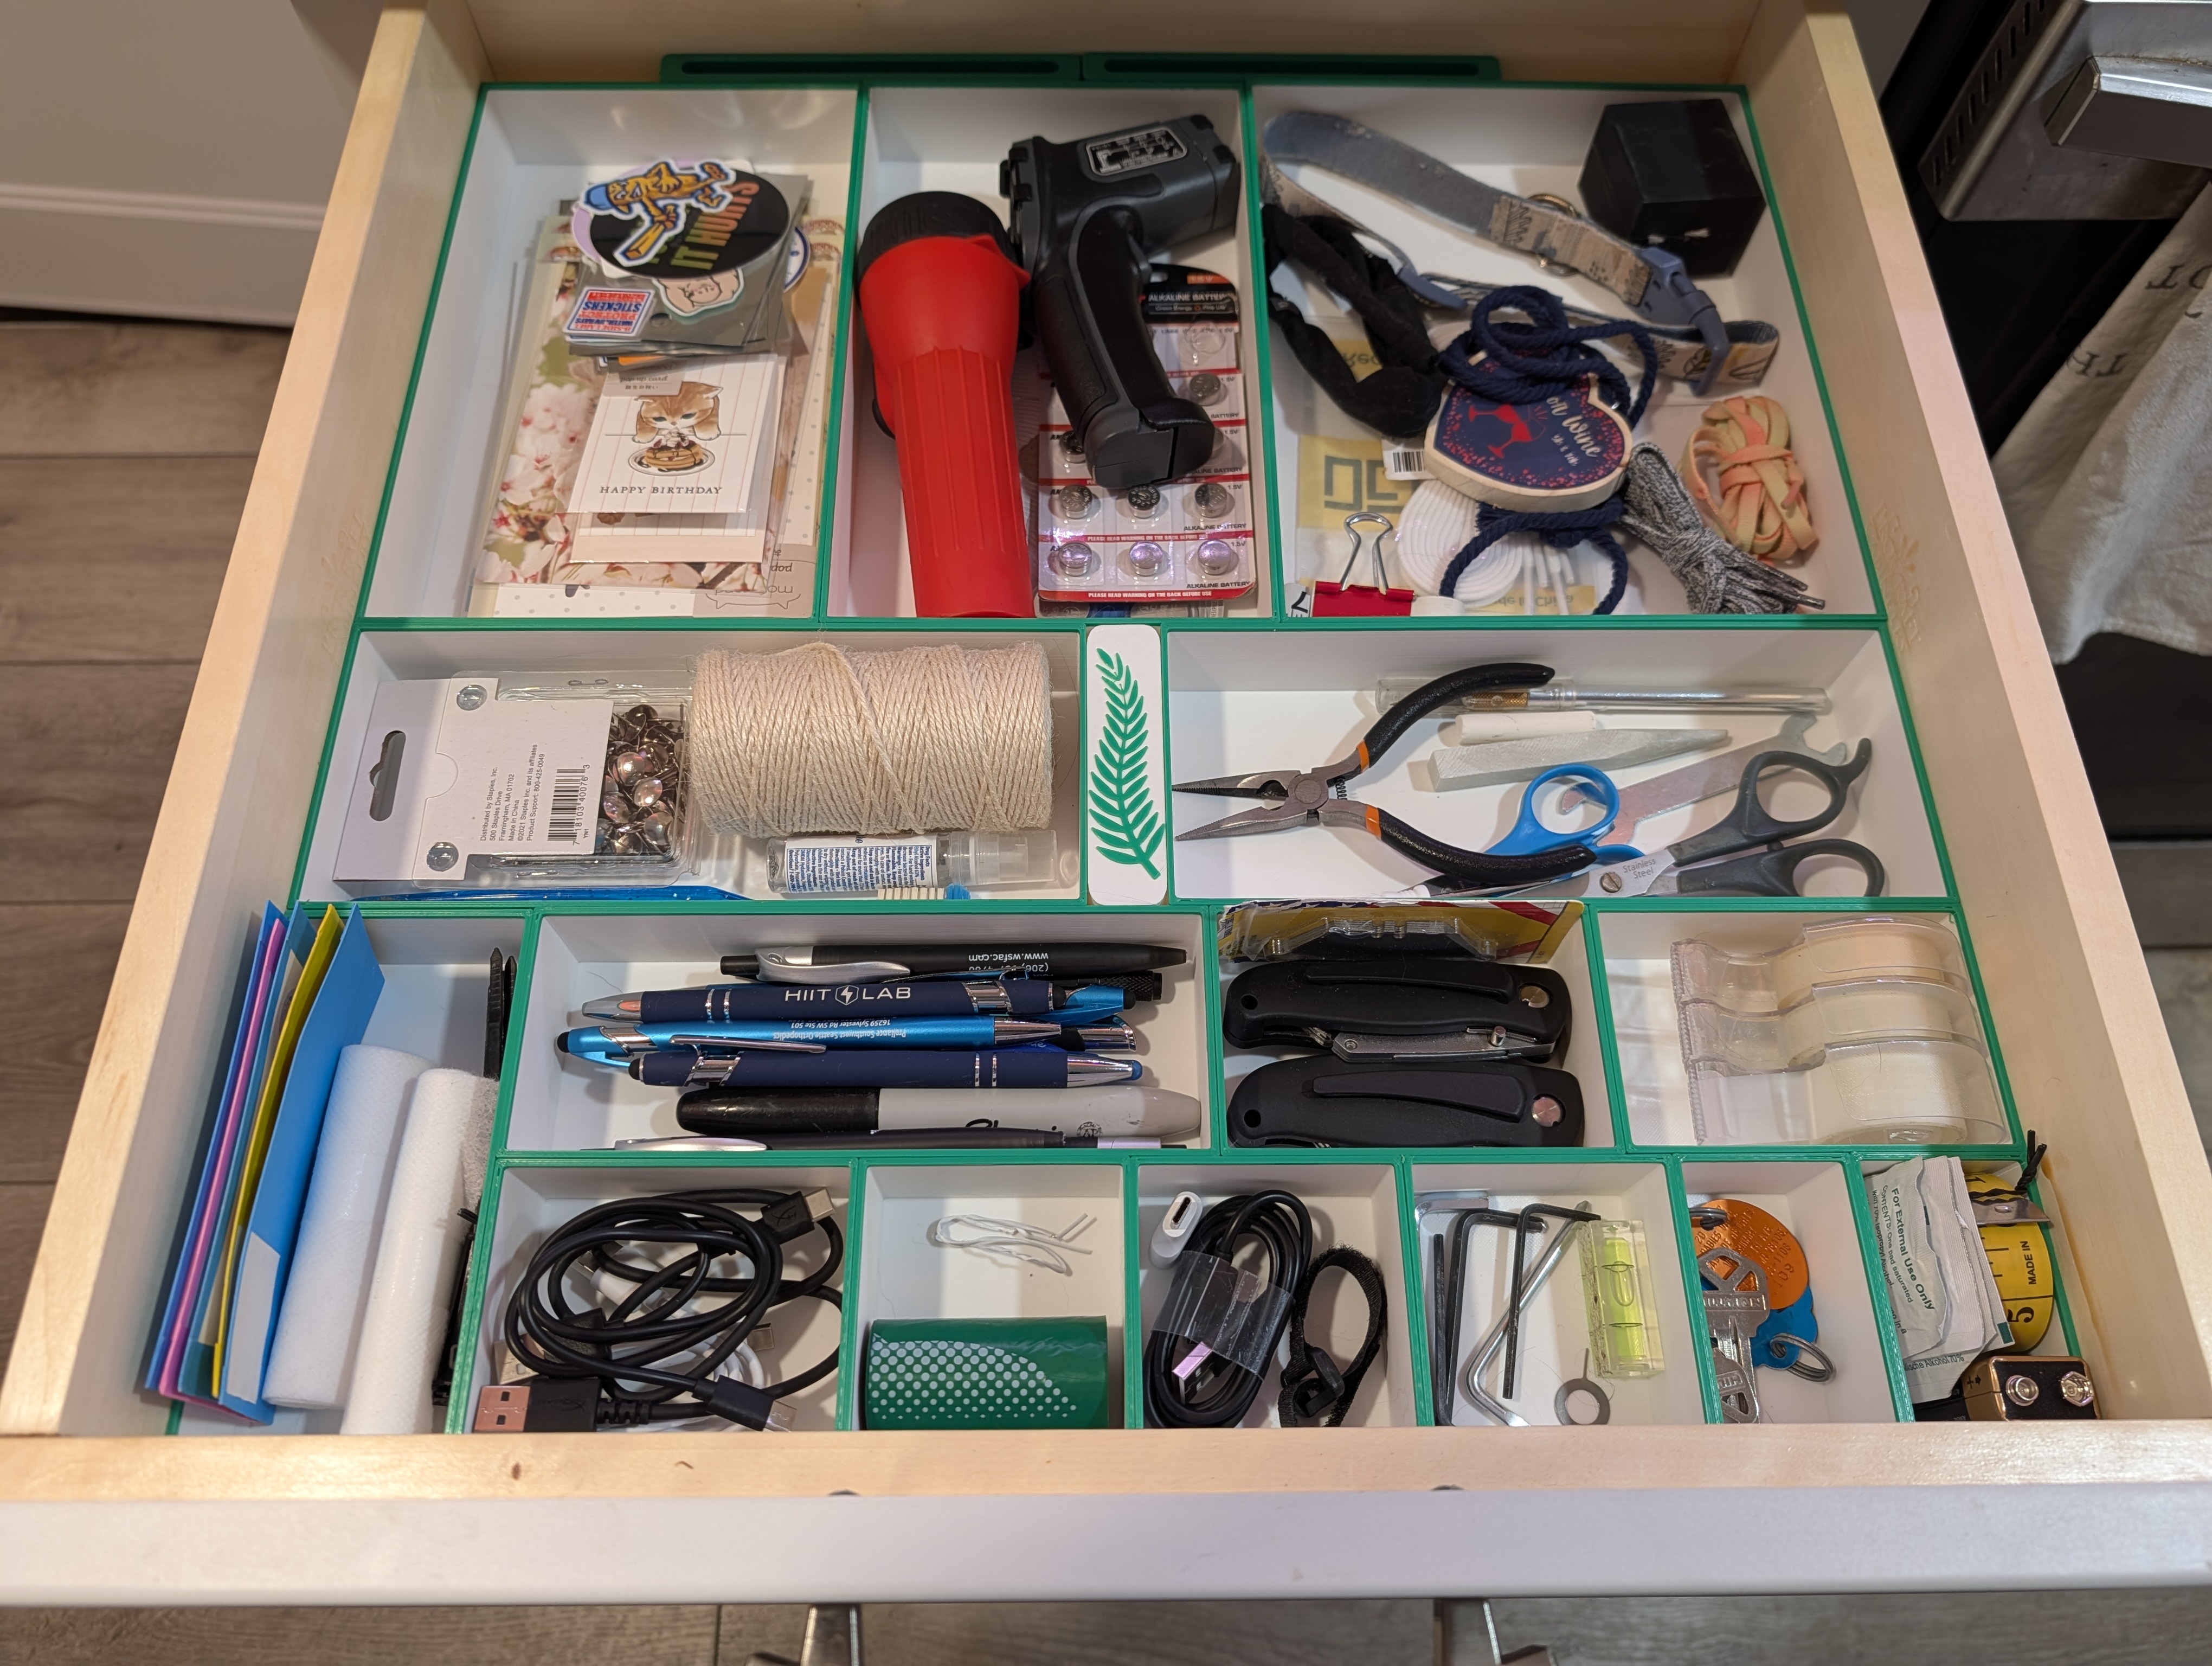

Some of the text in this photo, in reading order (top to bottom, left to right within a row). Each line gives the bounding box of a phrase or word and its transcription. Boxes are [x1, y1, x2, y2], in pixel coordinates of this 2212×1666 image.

[582, 301, 642, 312] STICKERS
[520, 799, 529, 820] Staples
[529, 744, 537, 766] affiliates
[579, 777, 588, 802] 40076
[480, 810, 491, 841] Distributed
[487, 778, 496, 800] Staples,
[526, 754, 545, 841] Product Support: 800-425-0049
[492, 807, 500, 829] Staples
[499, 804, 511, 841] Framingham,
[505, 792, 511, 802] MA
[575, 806, 584, 831] 18103
[1623, 859, 1656, 873] Stainless
[1633, 867, 1653, 879] Steel
[969, 953, 1049, 962] www.wsfac.com
[785, 987, 911, 1001] HIIT LAB
[773, 1028, 906, 1040] Proliance Southwest Seattle Orthopedics
[1875, 1222, 1886, 1257] Isopropyl
[1892, 1188, 1935, 1310] For External Use Only
[2020, 1241, 2037, 1285] MADE IN
[1893, 1266, 1914, 1303] saturated
[2007, 1306, 2035, 1323] 5
[1924, 1356, 1949, 1368] Alkohol
[1948, 1354, 1965, 1364] 70%
